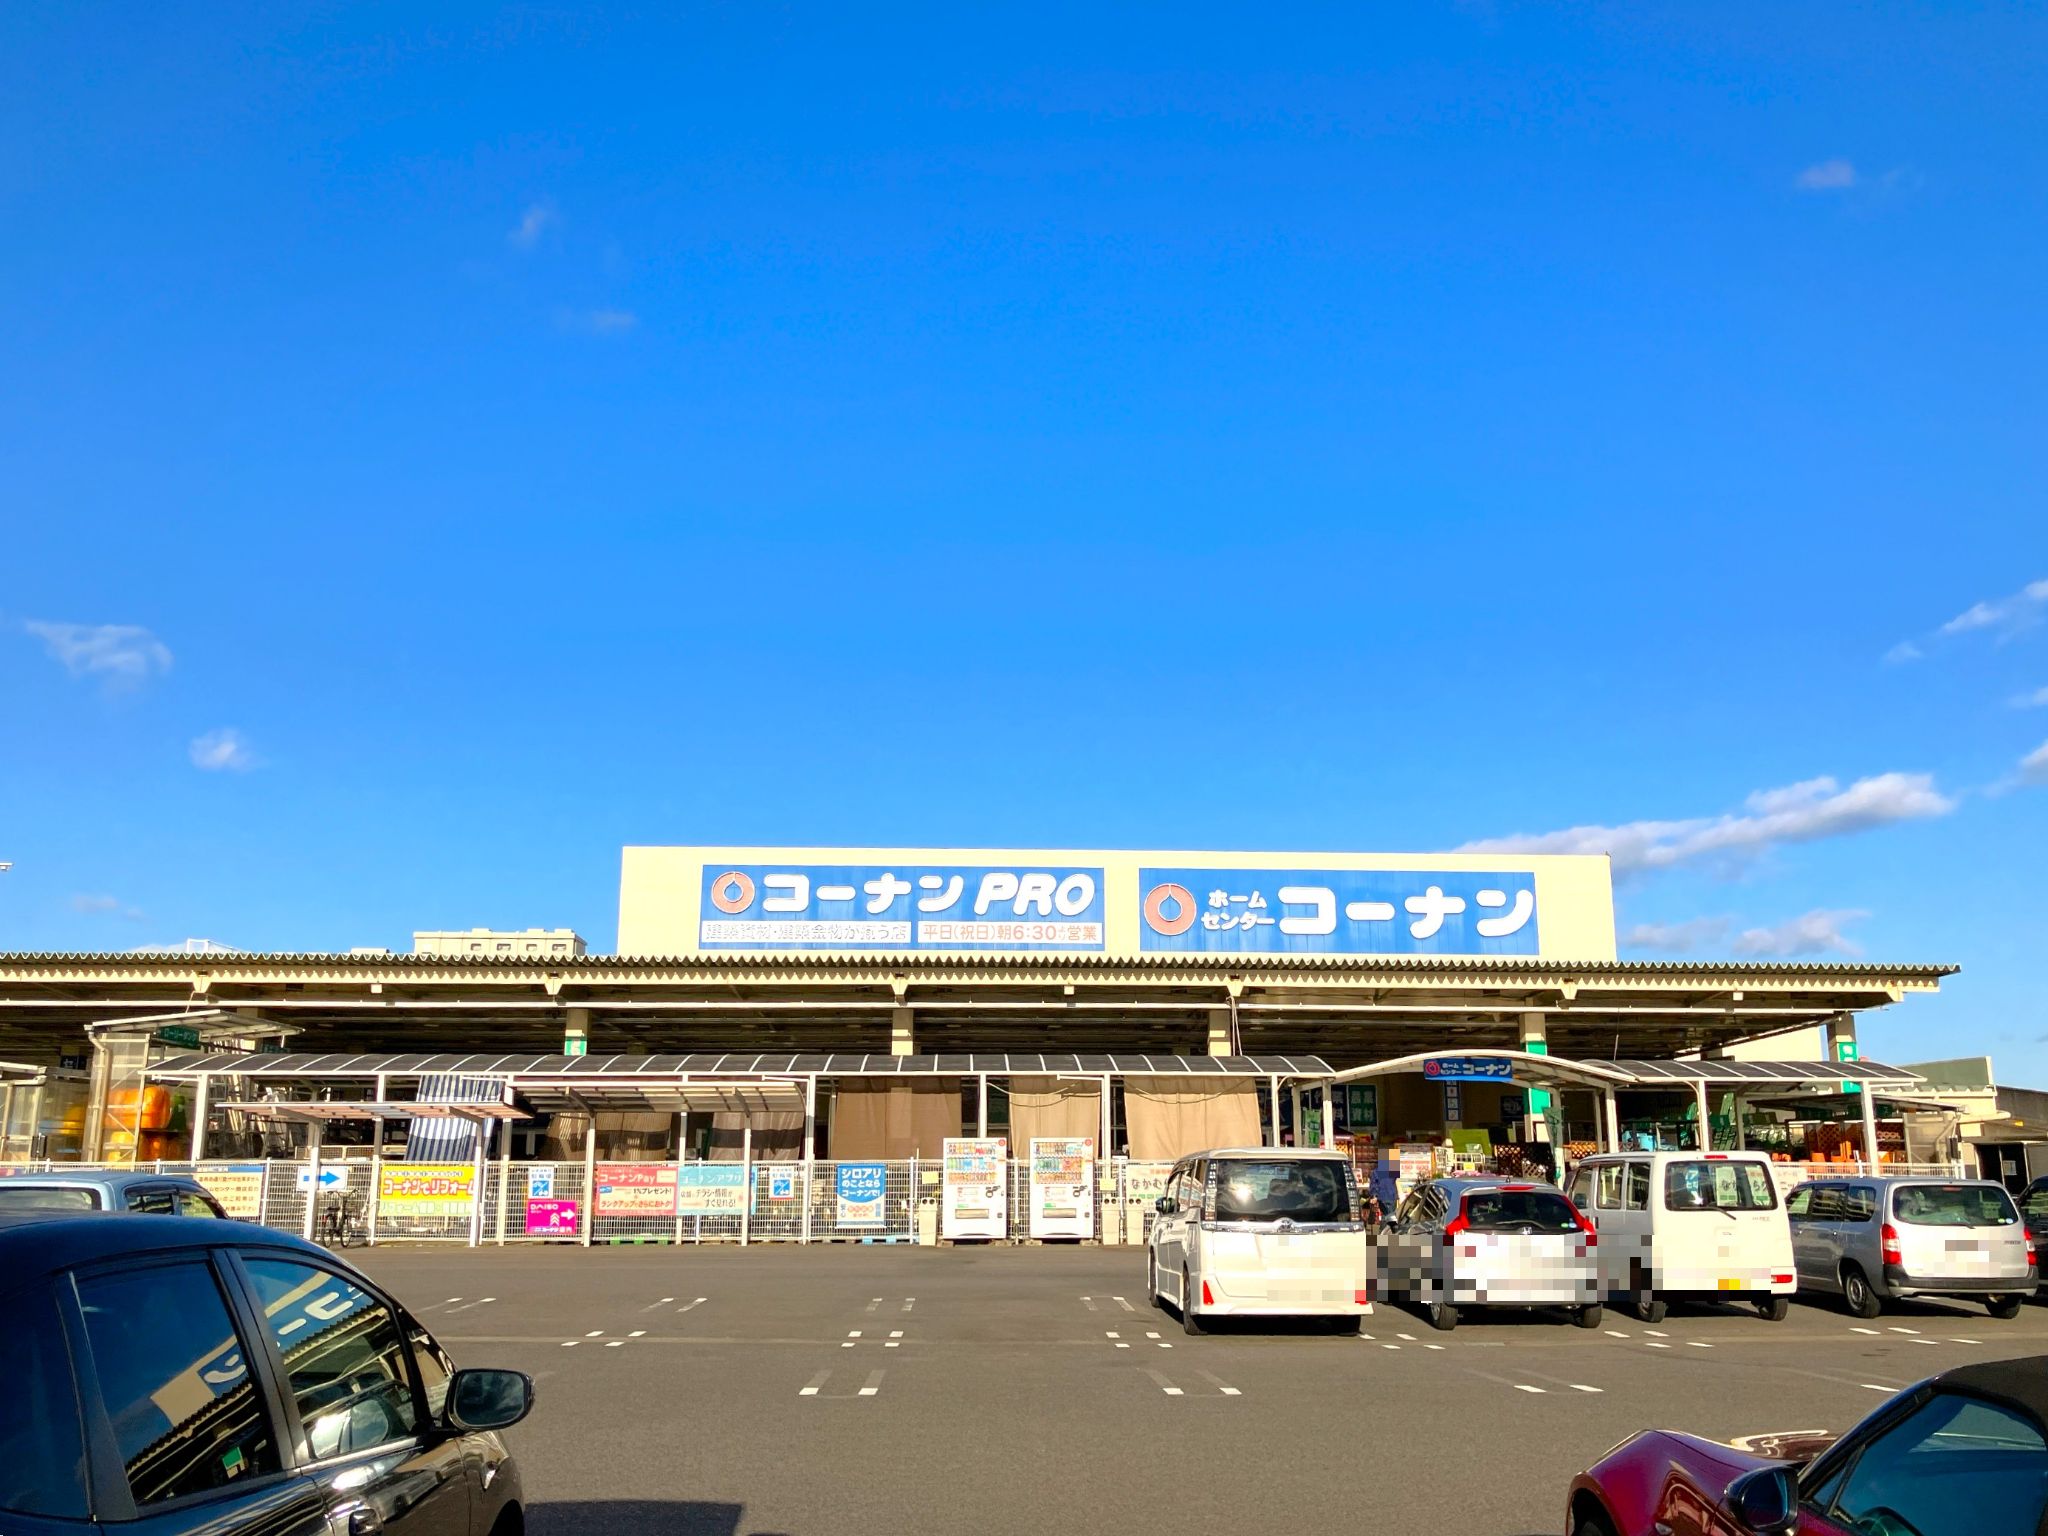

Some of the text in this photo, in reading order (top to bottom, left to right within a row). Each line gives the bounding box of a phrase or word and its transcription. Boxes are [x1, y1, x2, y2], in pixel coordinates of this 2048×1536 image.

[762, 872, 1095, 917] コーナン PRO
[1208, 889, 1268, 909] ホーム
[1278, 885, 1534, 940] コーナン
[1200, 912, 1275, 931] センター
[1463, 1063, 1511, 1076] コーナン
[599, 1174, 656, 1184] コーナンPay
[841, 1168, 882, 1179] シロアリ
[841, 1179, 881, 1188] のことなら
[1131, 1178, 1168, 1190] なかむ
